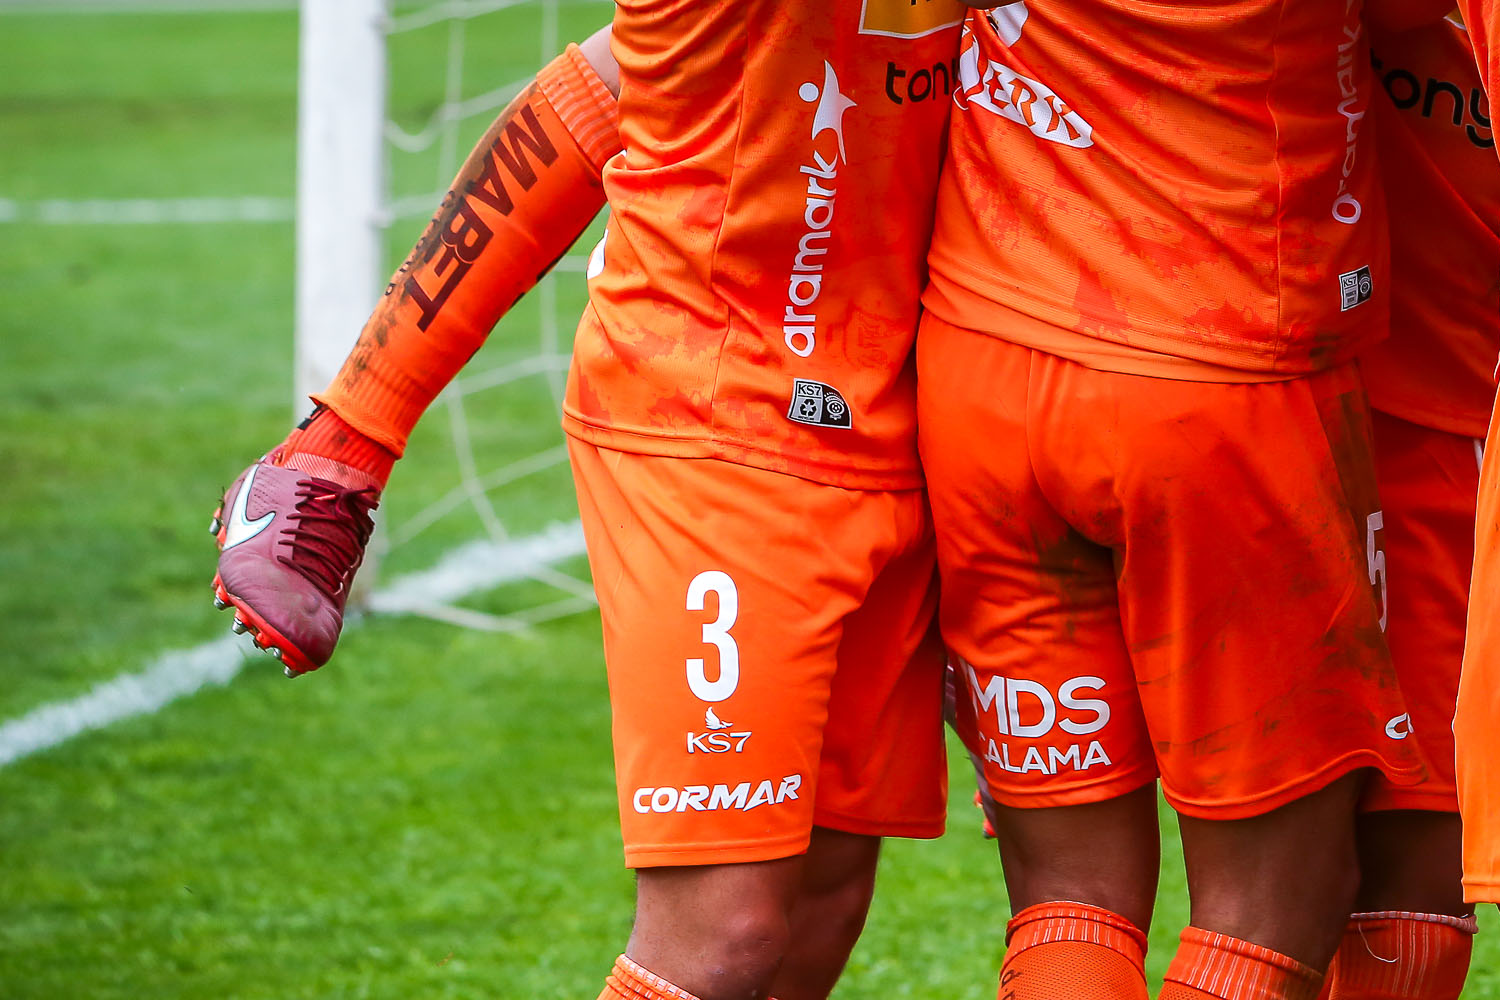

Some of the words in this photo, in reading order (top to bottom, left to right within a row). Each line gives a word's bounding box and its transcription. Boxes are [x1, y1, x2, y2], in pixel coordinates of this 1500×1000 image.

[885, 61, 960, 105] ton
[417, 102, 559, 334] MABET
[784, 150, 838, 358] aramark
[798, 383, 821, 396] KS7
[685, 570, 740, 702] 3
[967, 663, 1111, 738] MDS
[687, 731, 752, 754] KS7
[979, 732, 1112, 775] ALAMA
[633, 774, 802, 814] CORMAR
